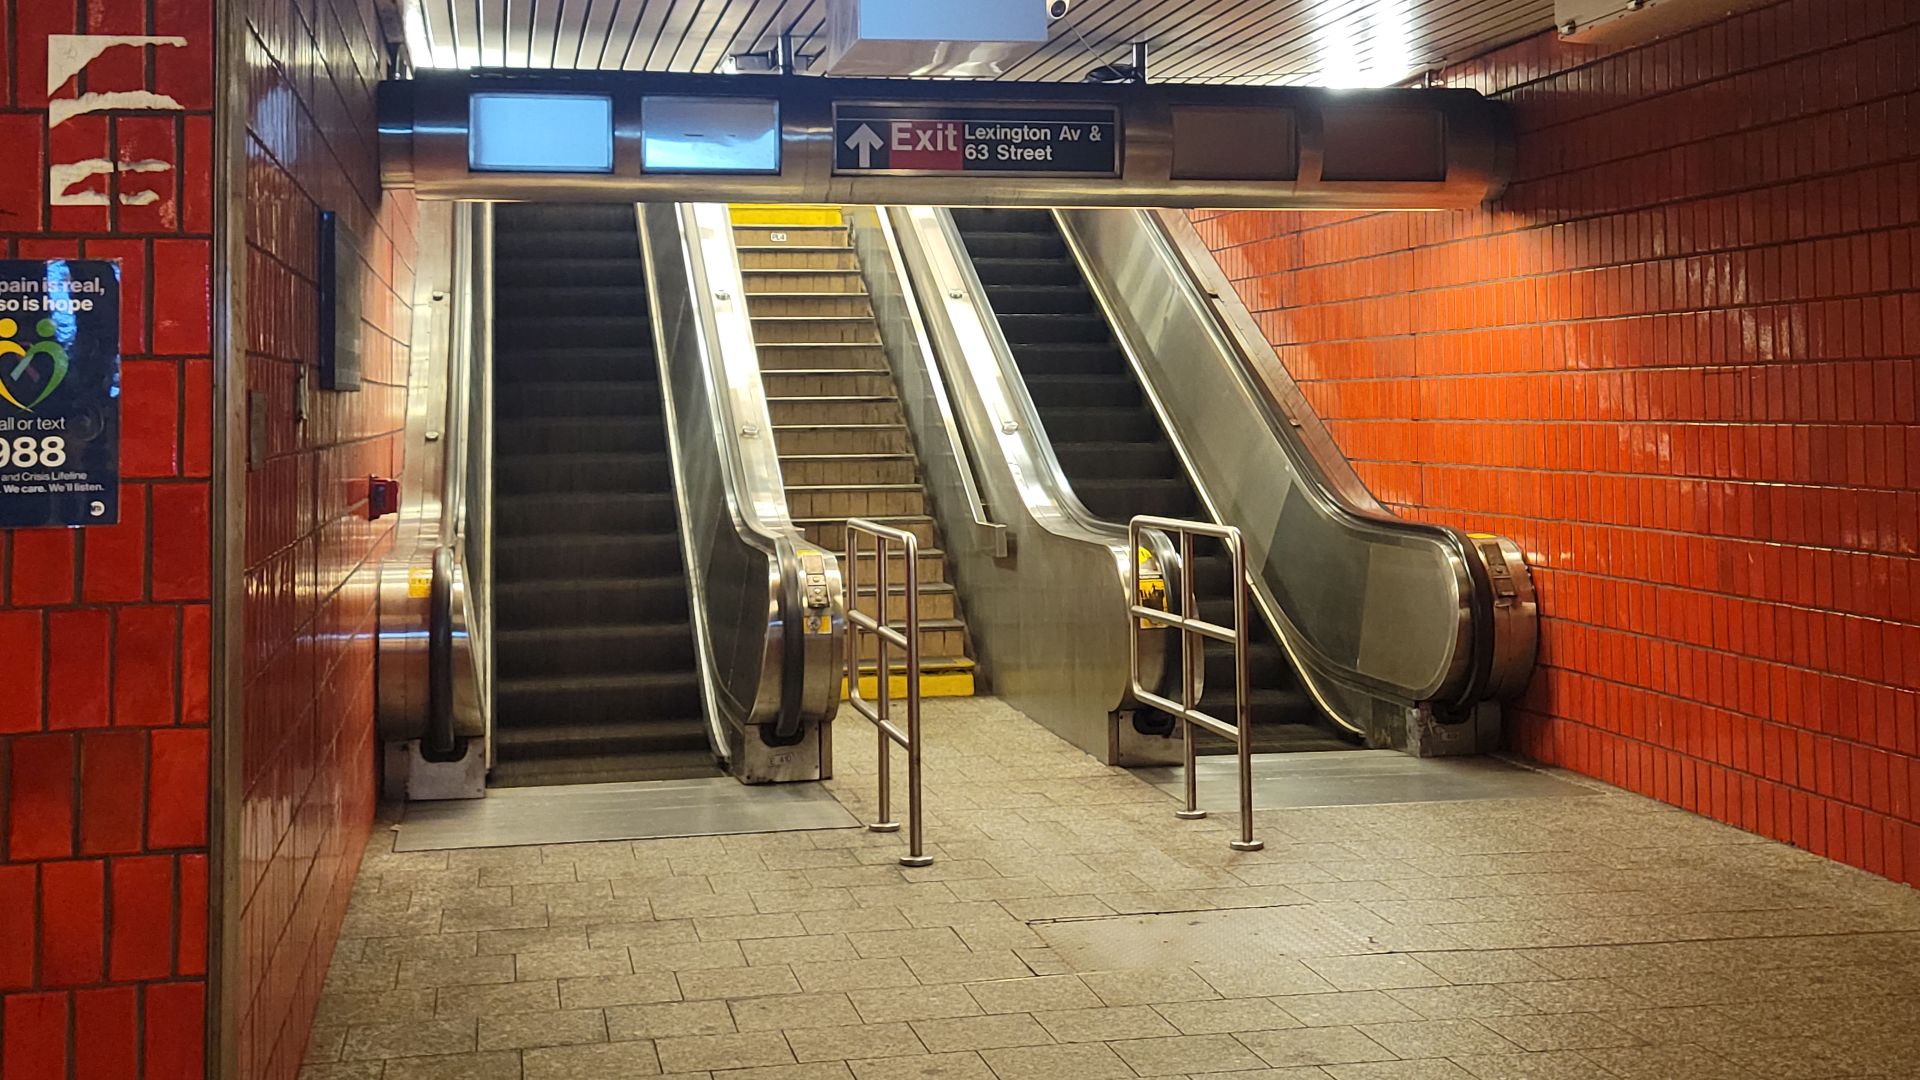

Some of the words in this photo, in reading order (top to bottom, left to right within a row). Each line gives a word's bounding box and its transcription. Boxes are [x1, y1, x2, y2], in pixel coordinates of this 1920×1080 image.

[891, 122, 958, 151] Exit
[964, 124, 1051, 142] Lexington
[1059, 125, 1081, 141] Av
[1089, 125, 1102, 142] &
[964, 144, 989, 160] 63
[997, 144, 1053, 161] Street
[0, 277, 39, 295] pain
[42, 277, 57, 293] is
[63, 277, 105, 296] real,
[0, 299, 20, 311] so
[22, 295, 40, 311] is
[43, 295, 93, 314] hope
[17, 419, 33, 430] or
[37, 417, 65, 430] text
[1, 473, 20, 481] and
[21, 472, 50, 481] Crisis
[51, 471, 87, 480] Lifeline
[3, 485, 20, 493] We
[21, 485, 47, 493] care.
[48, 483, 73, 492] We'll
[74, 482, 104, 491] listen.
